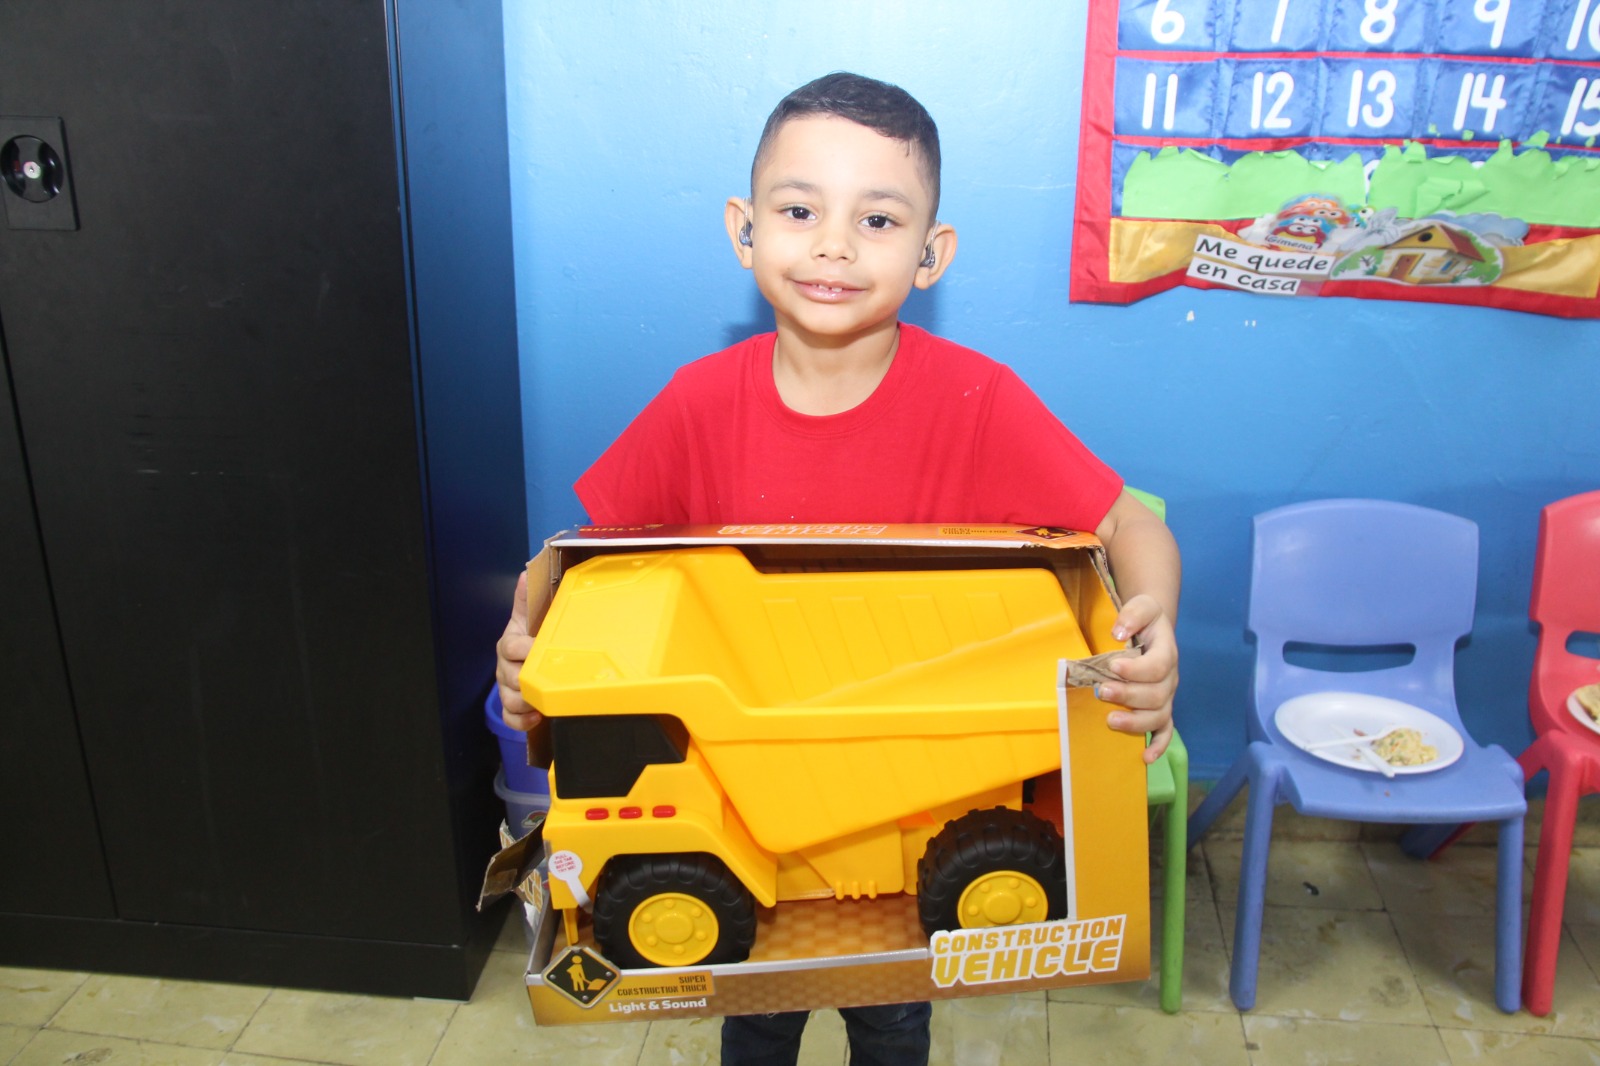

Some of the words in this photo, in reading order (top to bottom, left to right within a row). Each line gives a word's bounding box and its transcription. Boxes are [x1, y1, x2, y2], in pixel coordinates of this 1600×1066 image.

[1151, 0, 1185, 44] 6
[1359, 0, 1398, 44] 8
[1474, 0, 1511, 49] 9
[1142, 72, 1178, 130] 11
[1251, 71, 1295, 130] 12
[1347, 69, 1396, 128] 13
[1453, 72, 1507, 132] 14
[1560, 77, 1600, 137] 15
[1197, 238, 1237, 259] Me
[1247, 255, 1328, 270] quede
[1267, 235, 1314, 250] Gimena
[1197, 262, 1227, 279] en
[1237, 274, 1297, 291] casa
[934, 916, 1124, 955] CONSTRUCTION
[932, 938, 1121, 986] VEHICLE
[617, 985, 679, 996] CONSTRUCTION
[681, 984, 707, 993] TRUCK
[679, 975, 706, 984] SUPER
[609, 1001, 646, 1014] Light
[648, 1000, 660, 1010] &
[661, 997, 707, 1010] Sound
